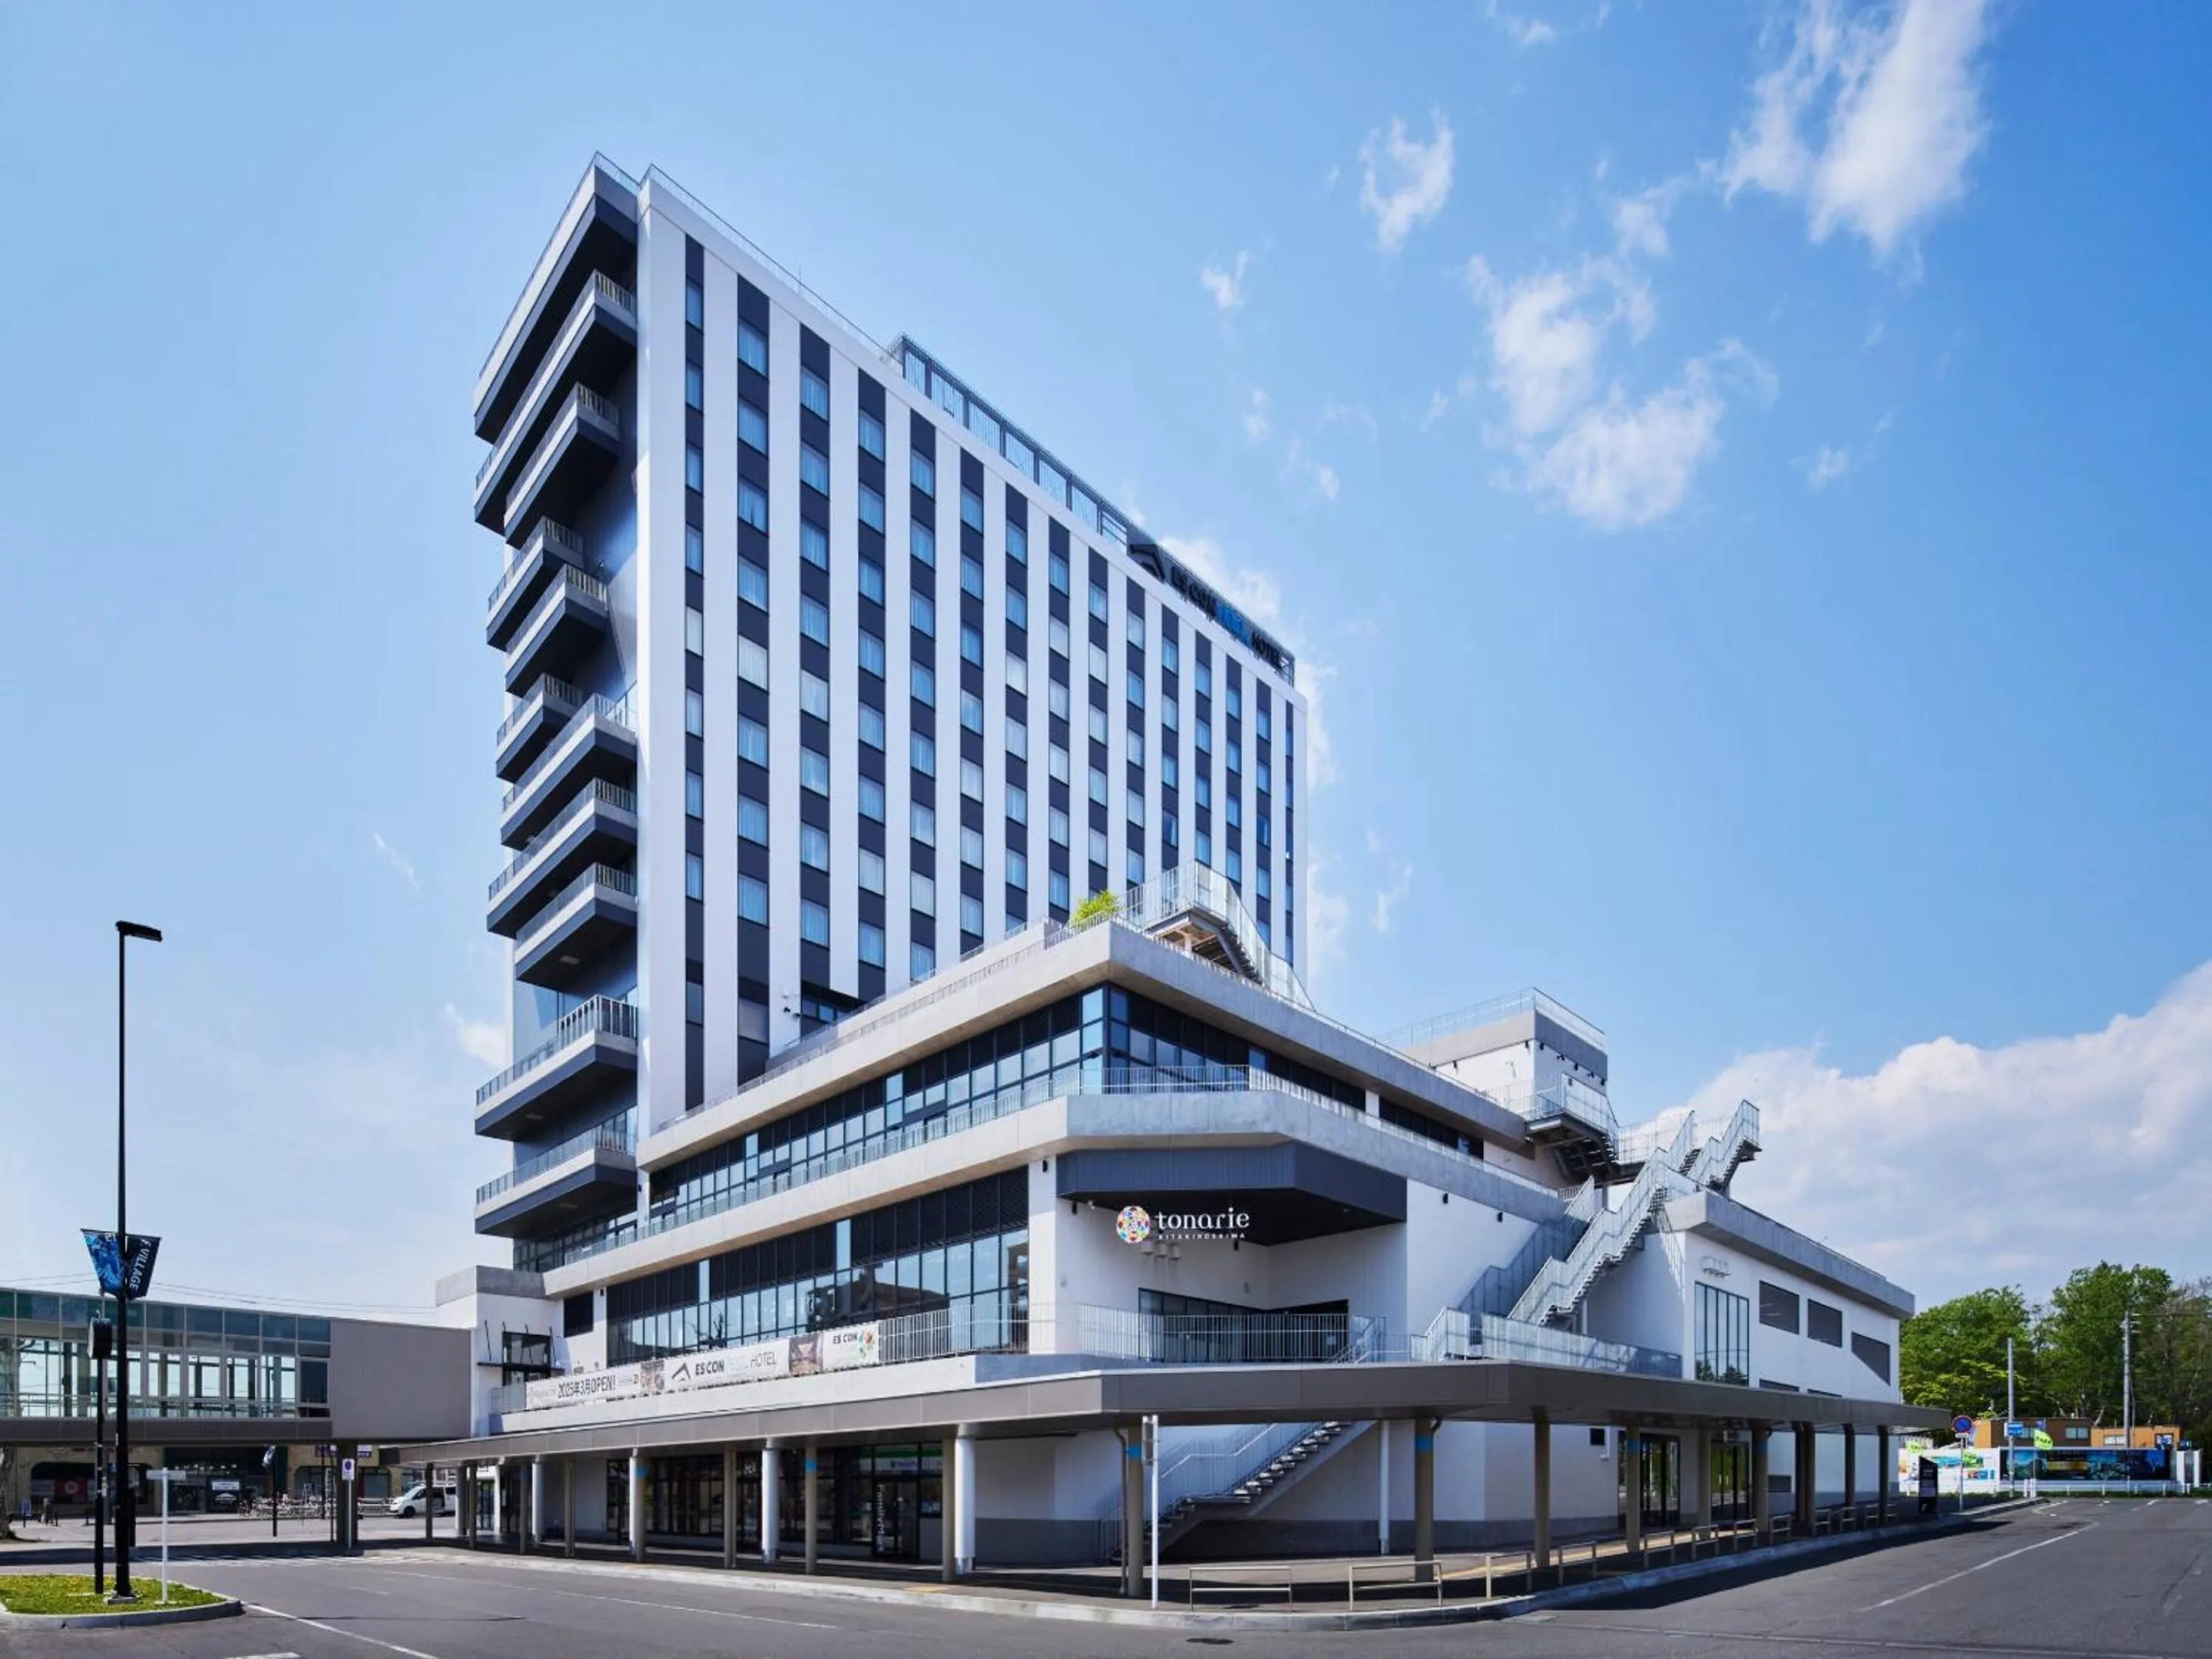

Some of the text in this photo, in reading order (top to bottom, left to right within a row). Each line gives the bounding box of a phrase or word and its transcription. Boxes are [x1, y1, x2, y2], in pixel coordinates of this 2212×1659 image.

[1154, 1207, 1250, 1230] tonarie
[129, 1247, 151, 1291] VILLAGE
[833, 1333, 858, 1345] ES CON
[695, 1362, 705, 1376] ES
[707, 1359, 725, 1374] CON
[750, 1352, 777, 1368] HOTEL
